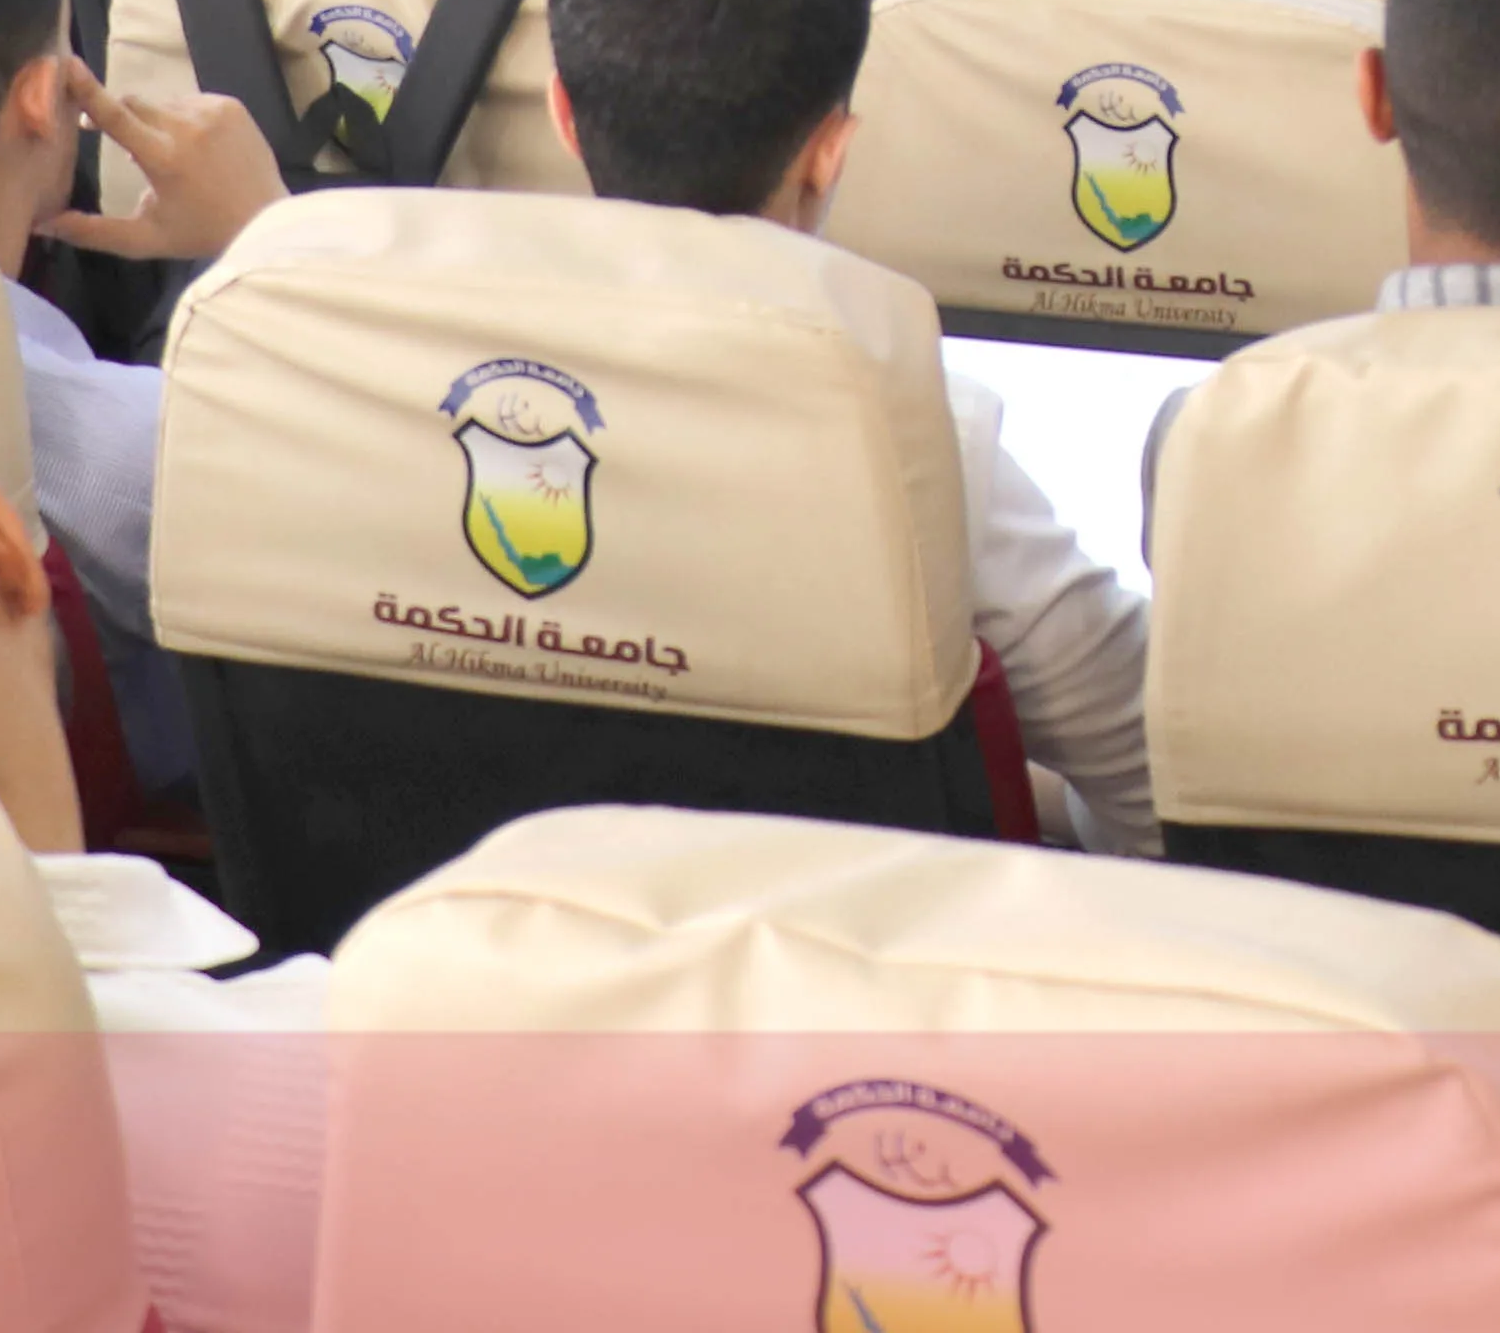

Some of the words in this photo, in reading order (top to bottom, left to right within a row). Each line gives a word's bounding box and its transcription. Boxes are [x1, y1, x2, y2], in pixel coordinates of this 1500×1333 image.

[1002, 256, 1126, 290] الحكمة
[1133, 267, 1256, 304] جامعة
[1136, 296, 1238, 329] University
[373, 591, 527, 648] الحكمة
[538, 621, 691, 677] جامعة
[538, 660, 668, 704] University
